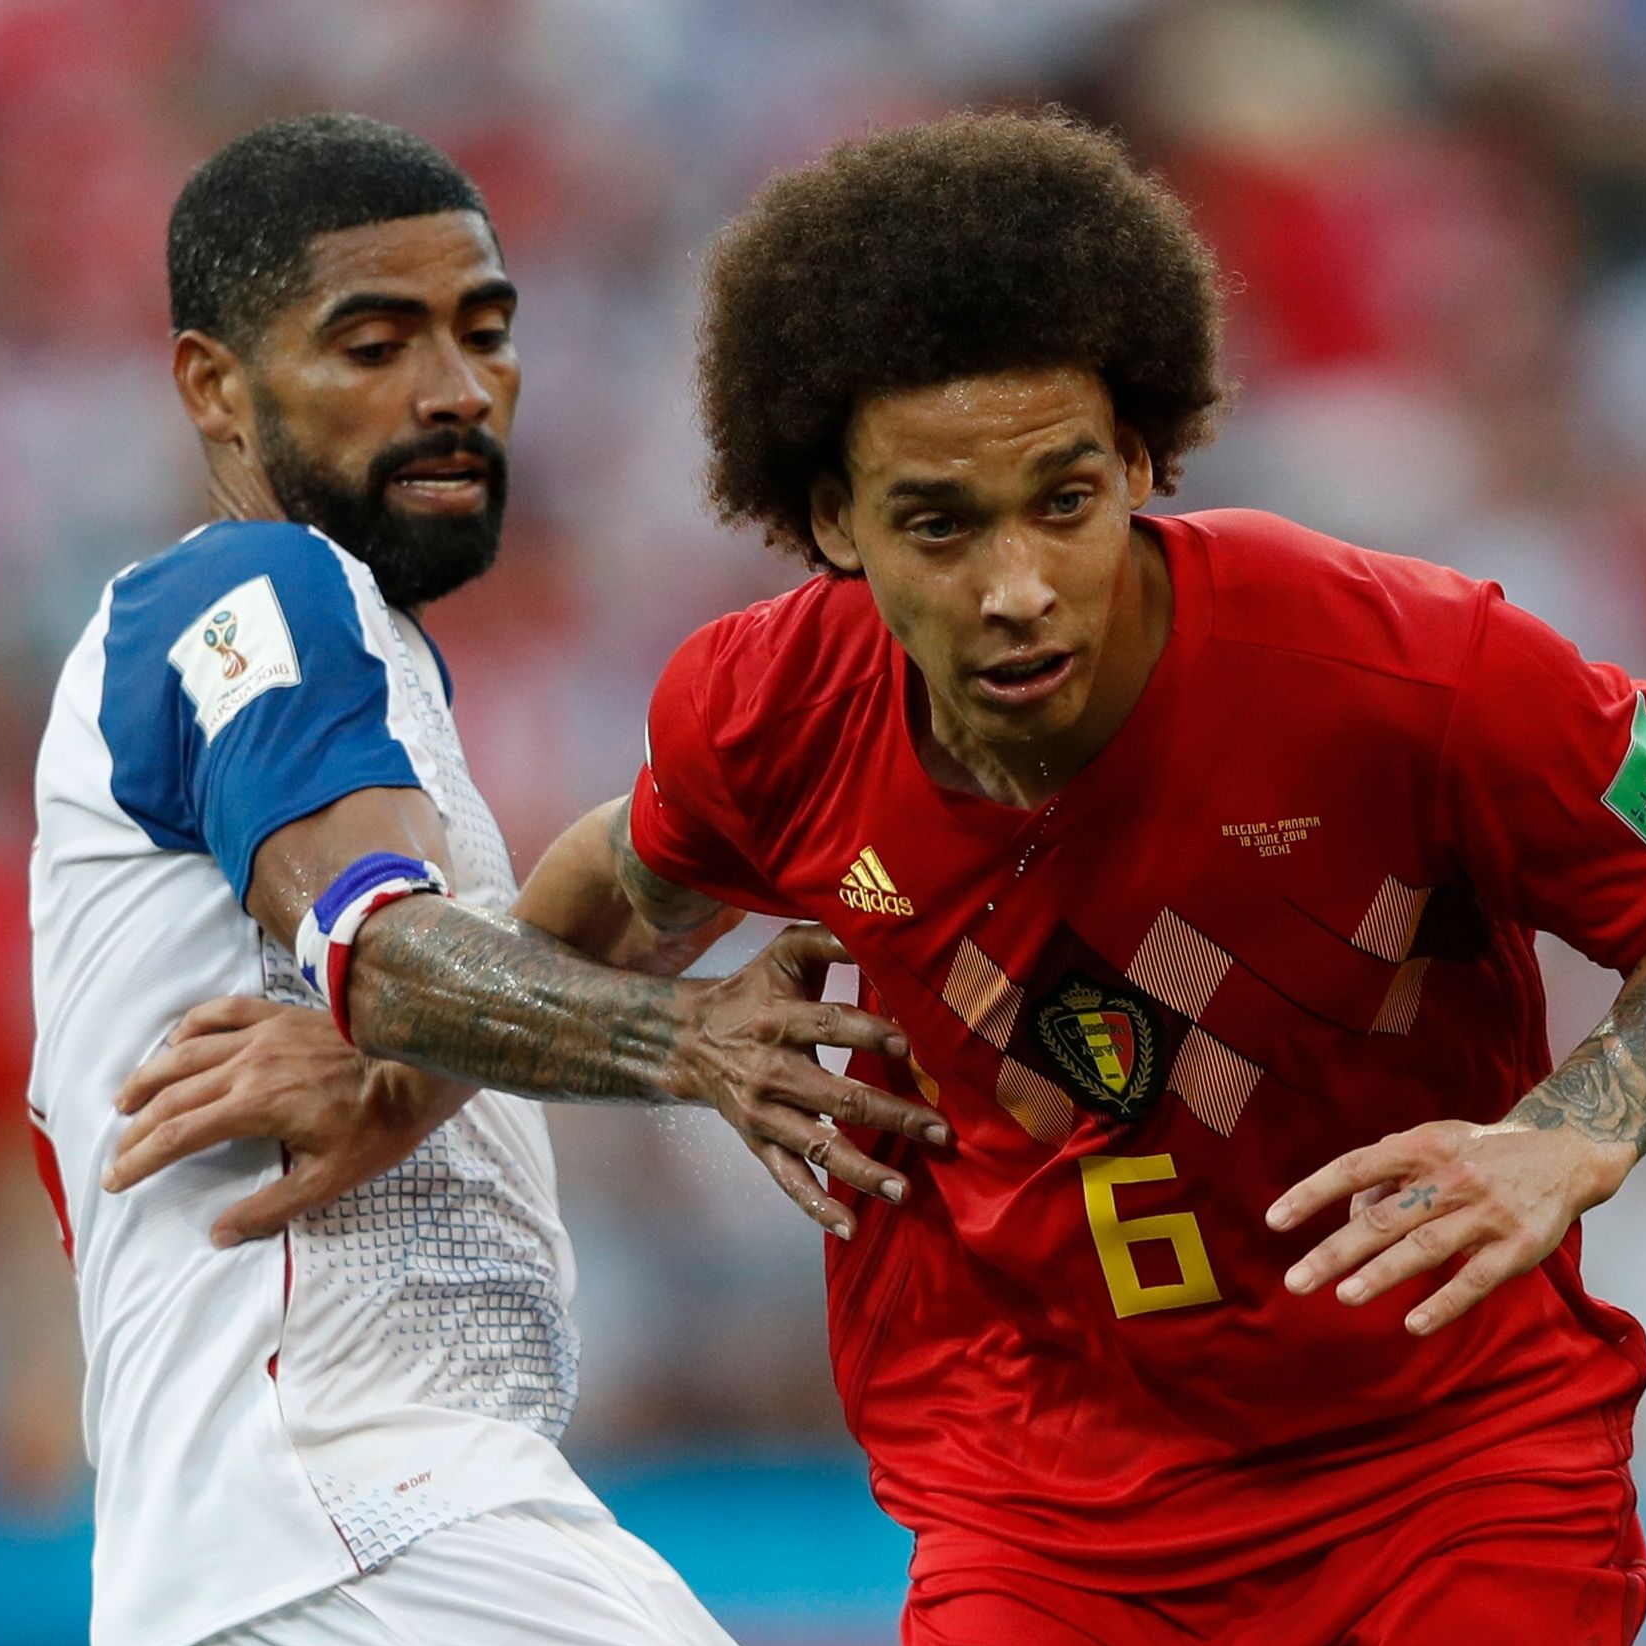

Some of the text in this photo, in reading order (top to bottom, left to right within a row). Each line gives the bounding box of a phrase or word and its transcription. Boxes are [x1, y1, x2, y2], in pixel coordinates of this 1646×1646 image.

[1221, 822, 1268, 837] BELGIUM
[1277, 816, 1321, 832] PANAMA
[1239, 829, 1308, 848] 18 JUNE 2018
[1258, 843, 1292, 858] SOCHI
[838, 886, 915, 917] adidas
[1077, 1152, 1223, 1319] 6
